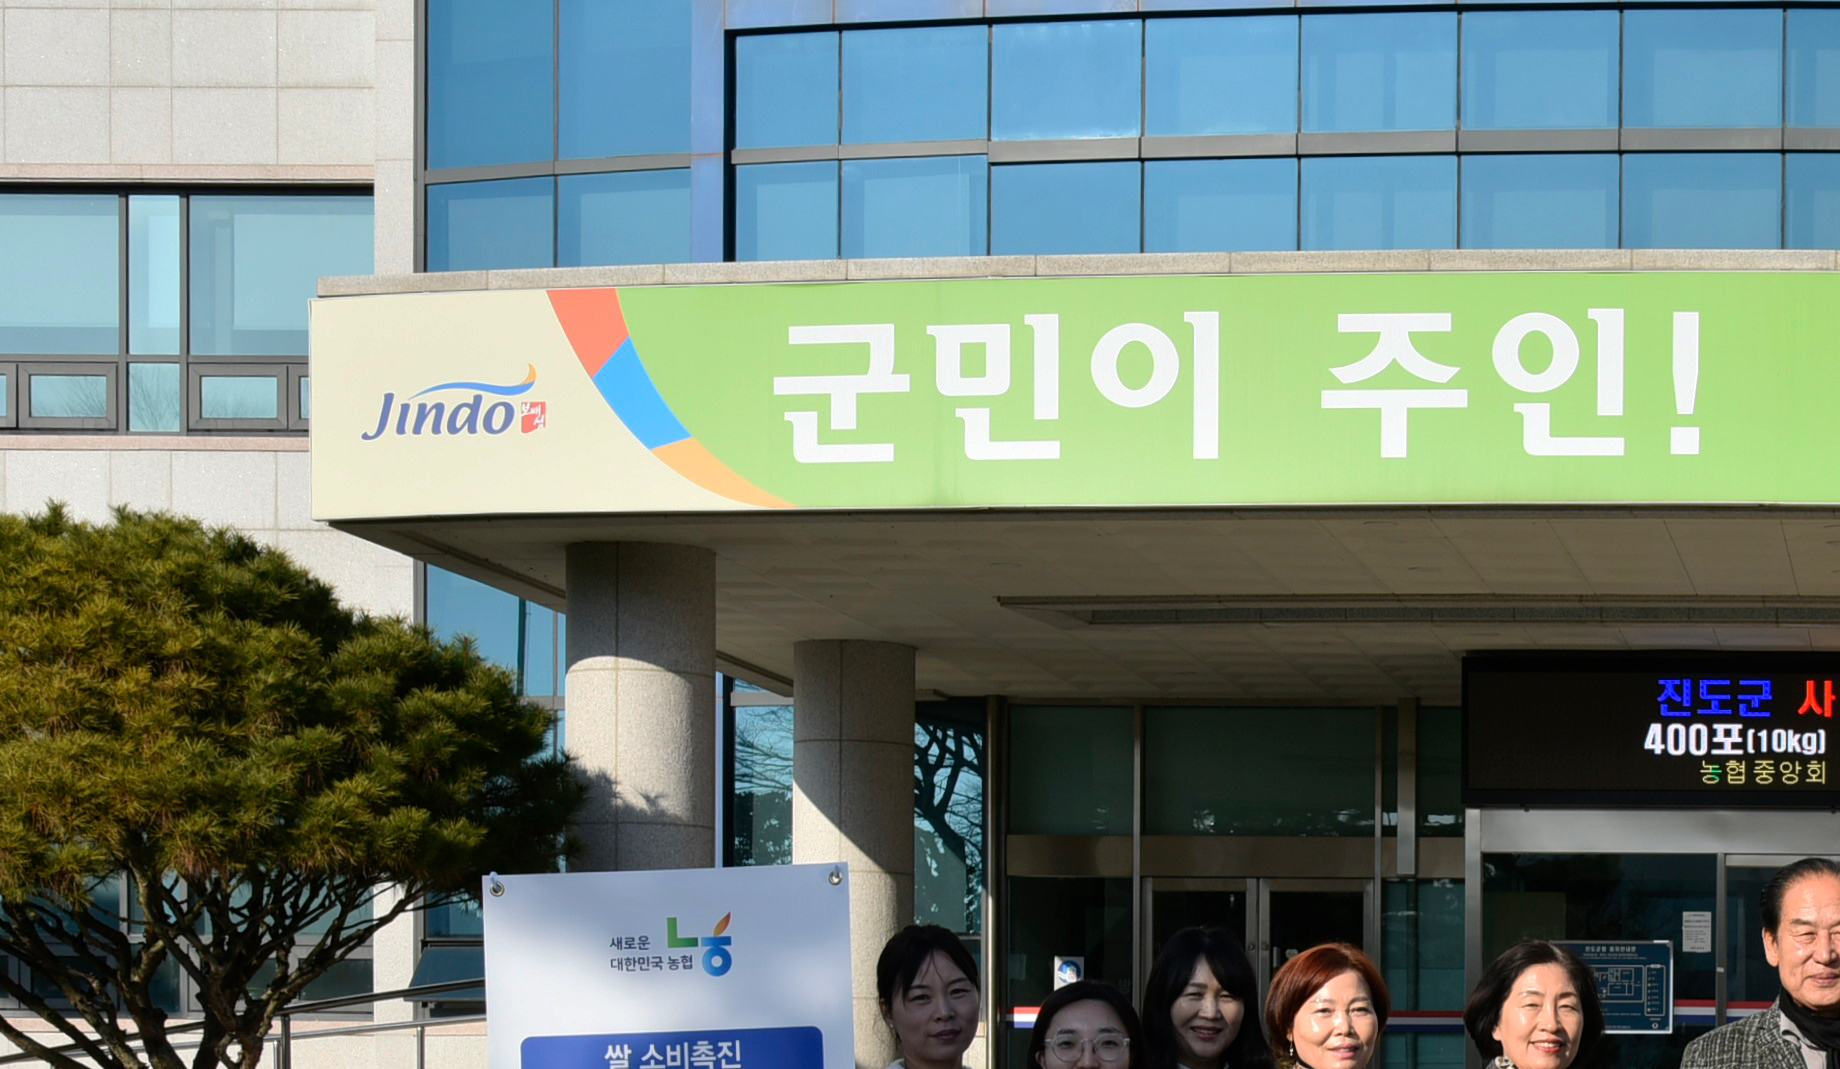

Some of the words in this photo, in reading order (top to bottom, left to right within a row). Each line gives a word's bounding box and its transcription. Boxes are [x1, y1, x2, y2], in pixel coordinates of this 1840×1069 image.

[774, 311, 1219, 463] 군민이
[1322, 308, 1700, 458] 주인!
[361, 392, 515, 440] Jindo
[1658, 679, 1772, 717] 진도군
[1644, 723, 1825, 755] 400포(10kg)
[1700, 760, 1825, 784] 농협중앙회
[610, 936, 650, 950] 새로운
[611, 956, 663, 971] 대한민국
[667, 955, 693, 970] 농협
